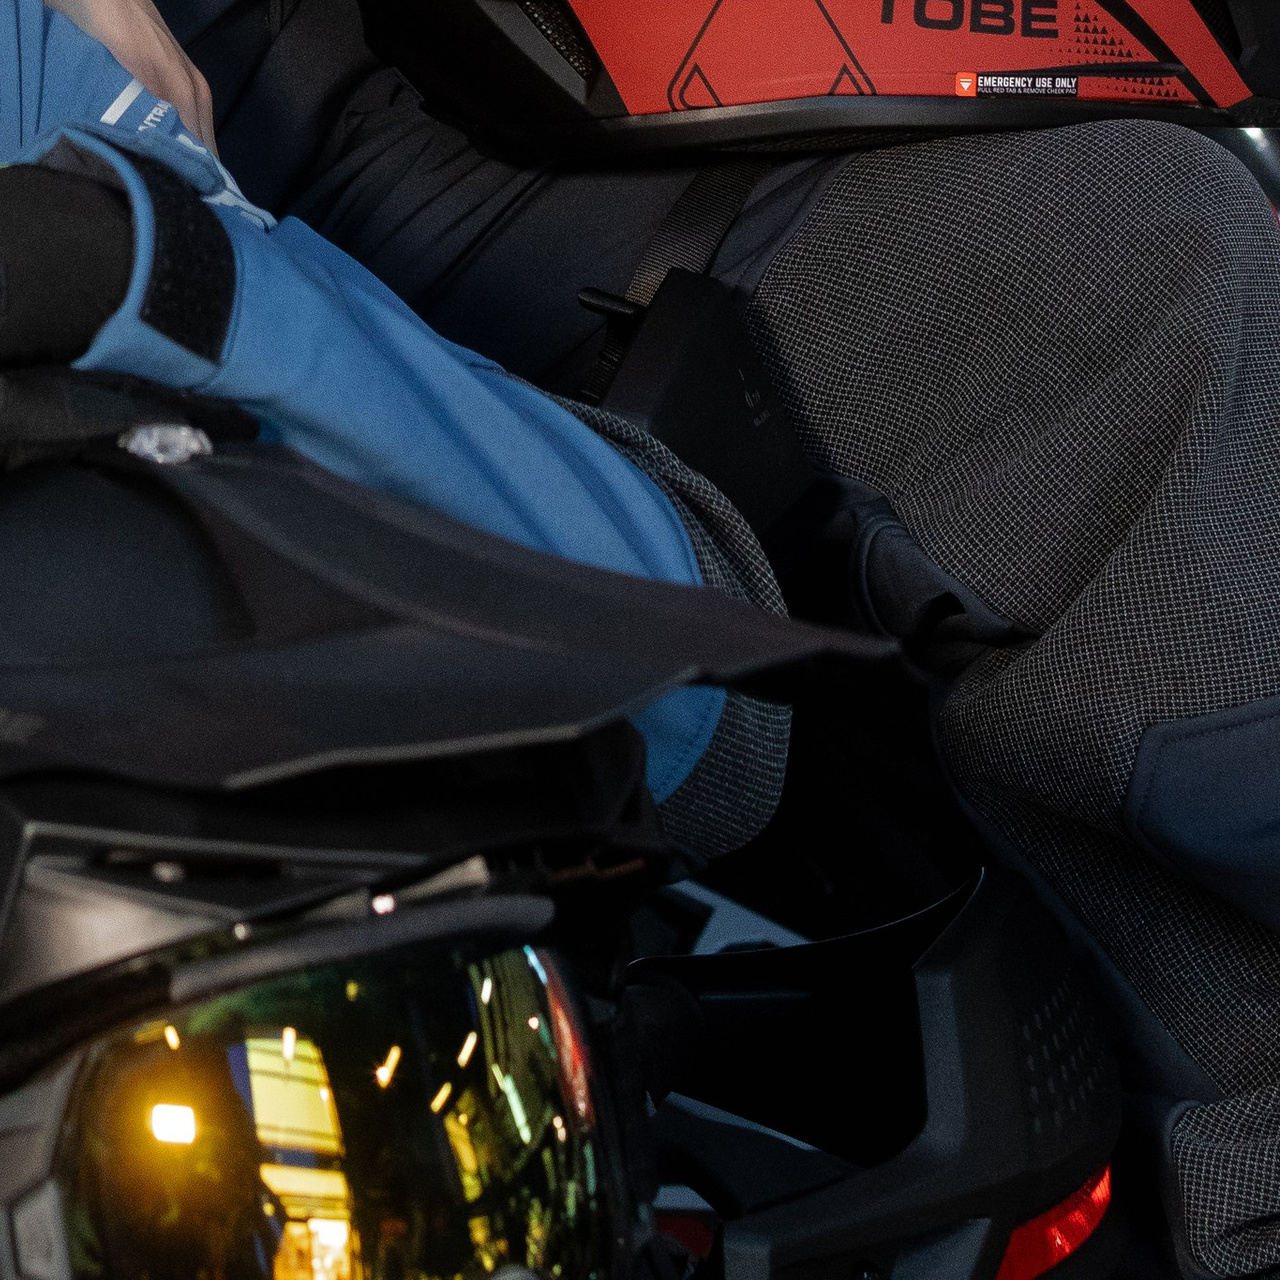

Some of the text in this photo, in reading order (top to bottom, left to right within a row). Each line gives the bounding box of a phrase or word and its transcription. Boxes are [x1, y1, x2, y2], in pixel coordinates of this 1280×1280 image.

[977, 76, 1077, 89] EMERGENCY USE ONLY
